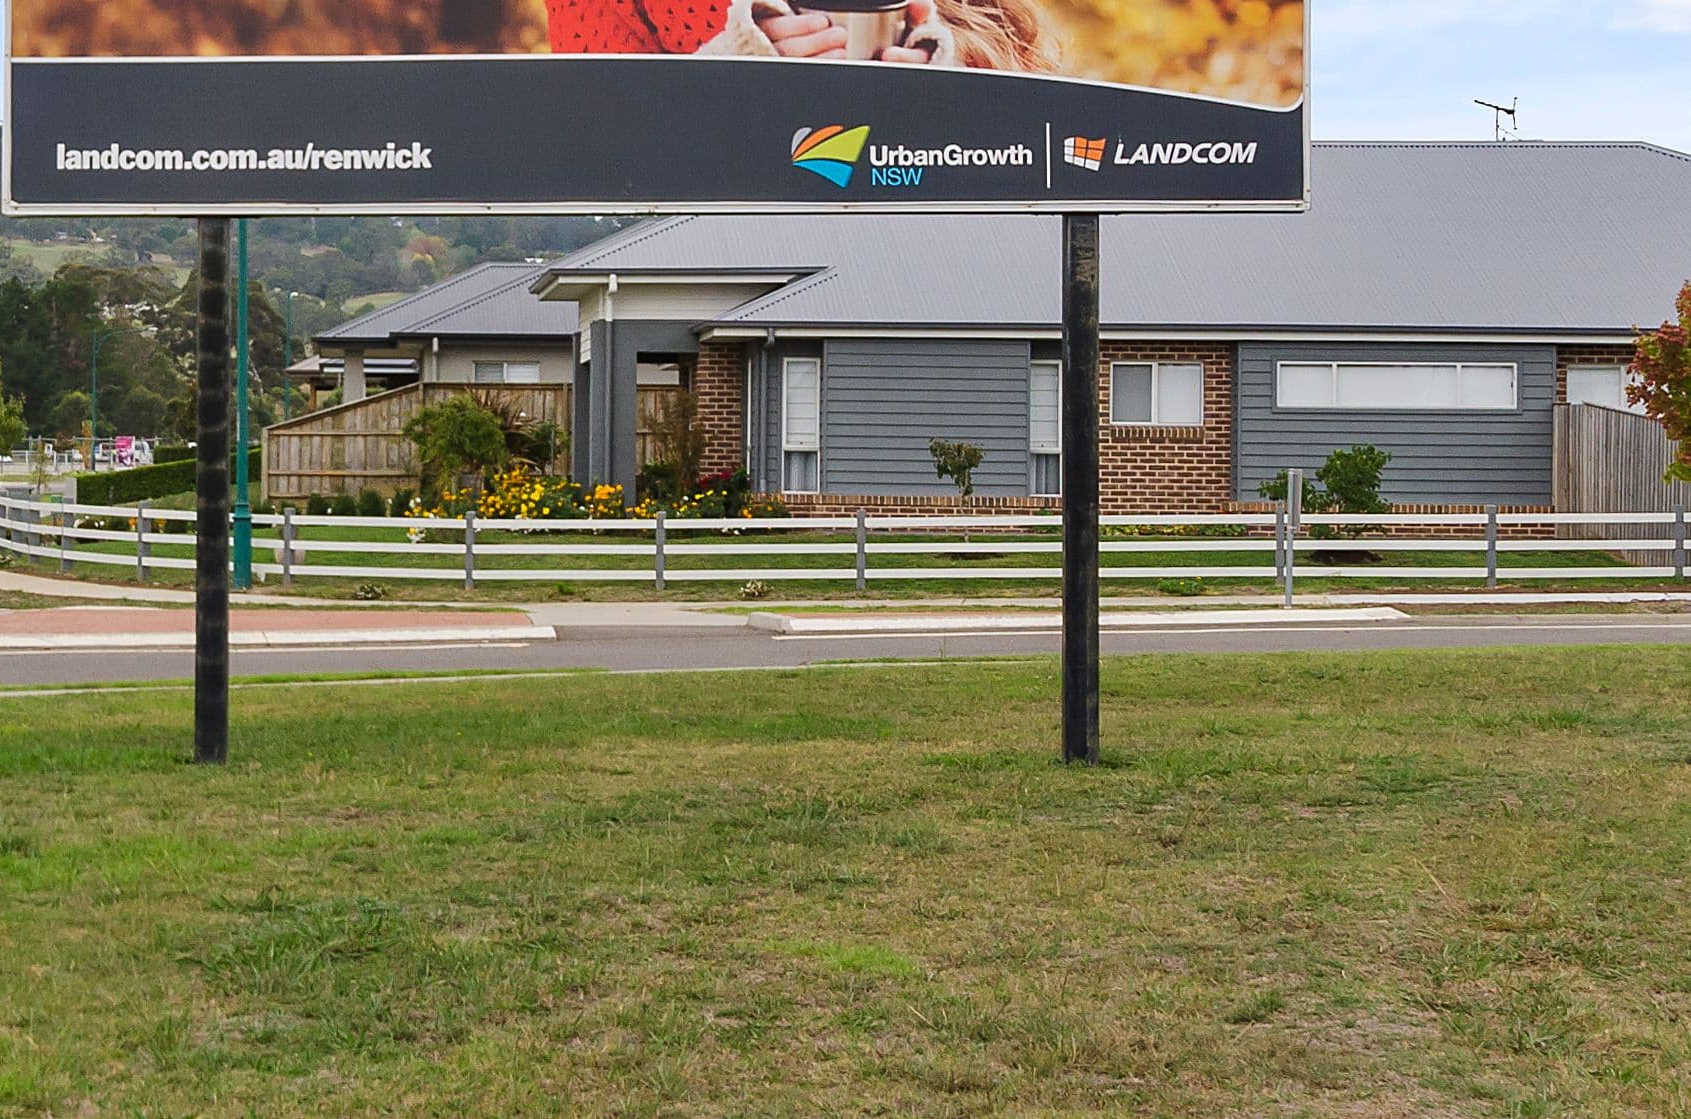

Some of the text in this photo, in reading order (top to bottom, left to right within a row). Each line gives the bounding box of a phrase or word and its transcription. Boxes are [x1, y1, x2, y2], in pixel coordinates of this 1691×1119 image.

[55, 141, 434, 171] landcom.com.au/renwick
[869, 143, 1034, 168] UrbanGrowth
[1113, 141, 1258, 166] LANDCOM
[870, 166, 923, 188] NSW
